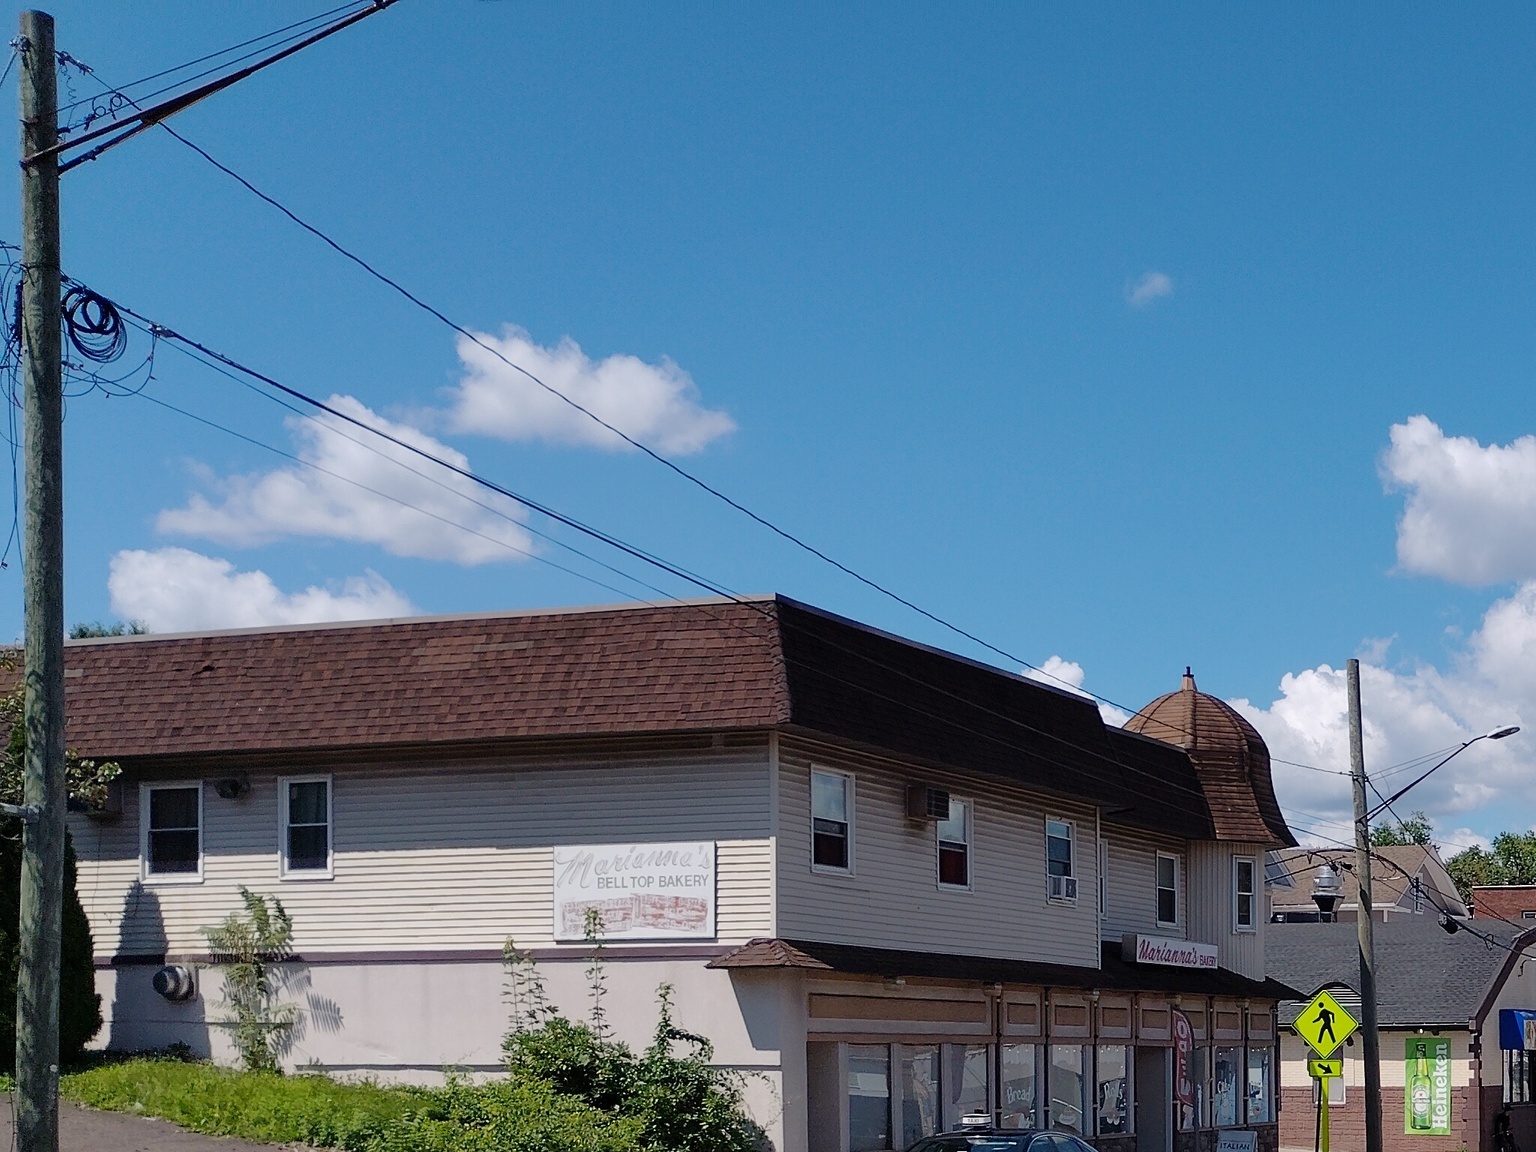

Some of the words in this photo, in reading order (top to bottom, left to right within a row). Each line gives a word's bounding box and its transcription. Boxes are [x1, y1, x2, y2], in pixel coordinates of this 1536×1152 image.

[555, 845, 712, 889] Marianna's
[597, 876, 629, 889] BELL
[630, 875, 655, 889] TOP
[658, 874, 709, 888] BAKERY
[1139, 939, 1197, 965] Marianna's
[1006, 1086, 1032, 1104] Bread
[1432, 1043, 1448, 1128] Heineken
